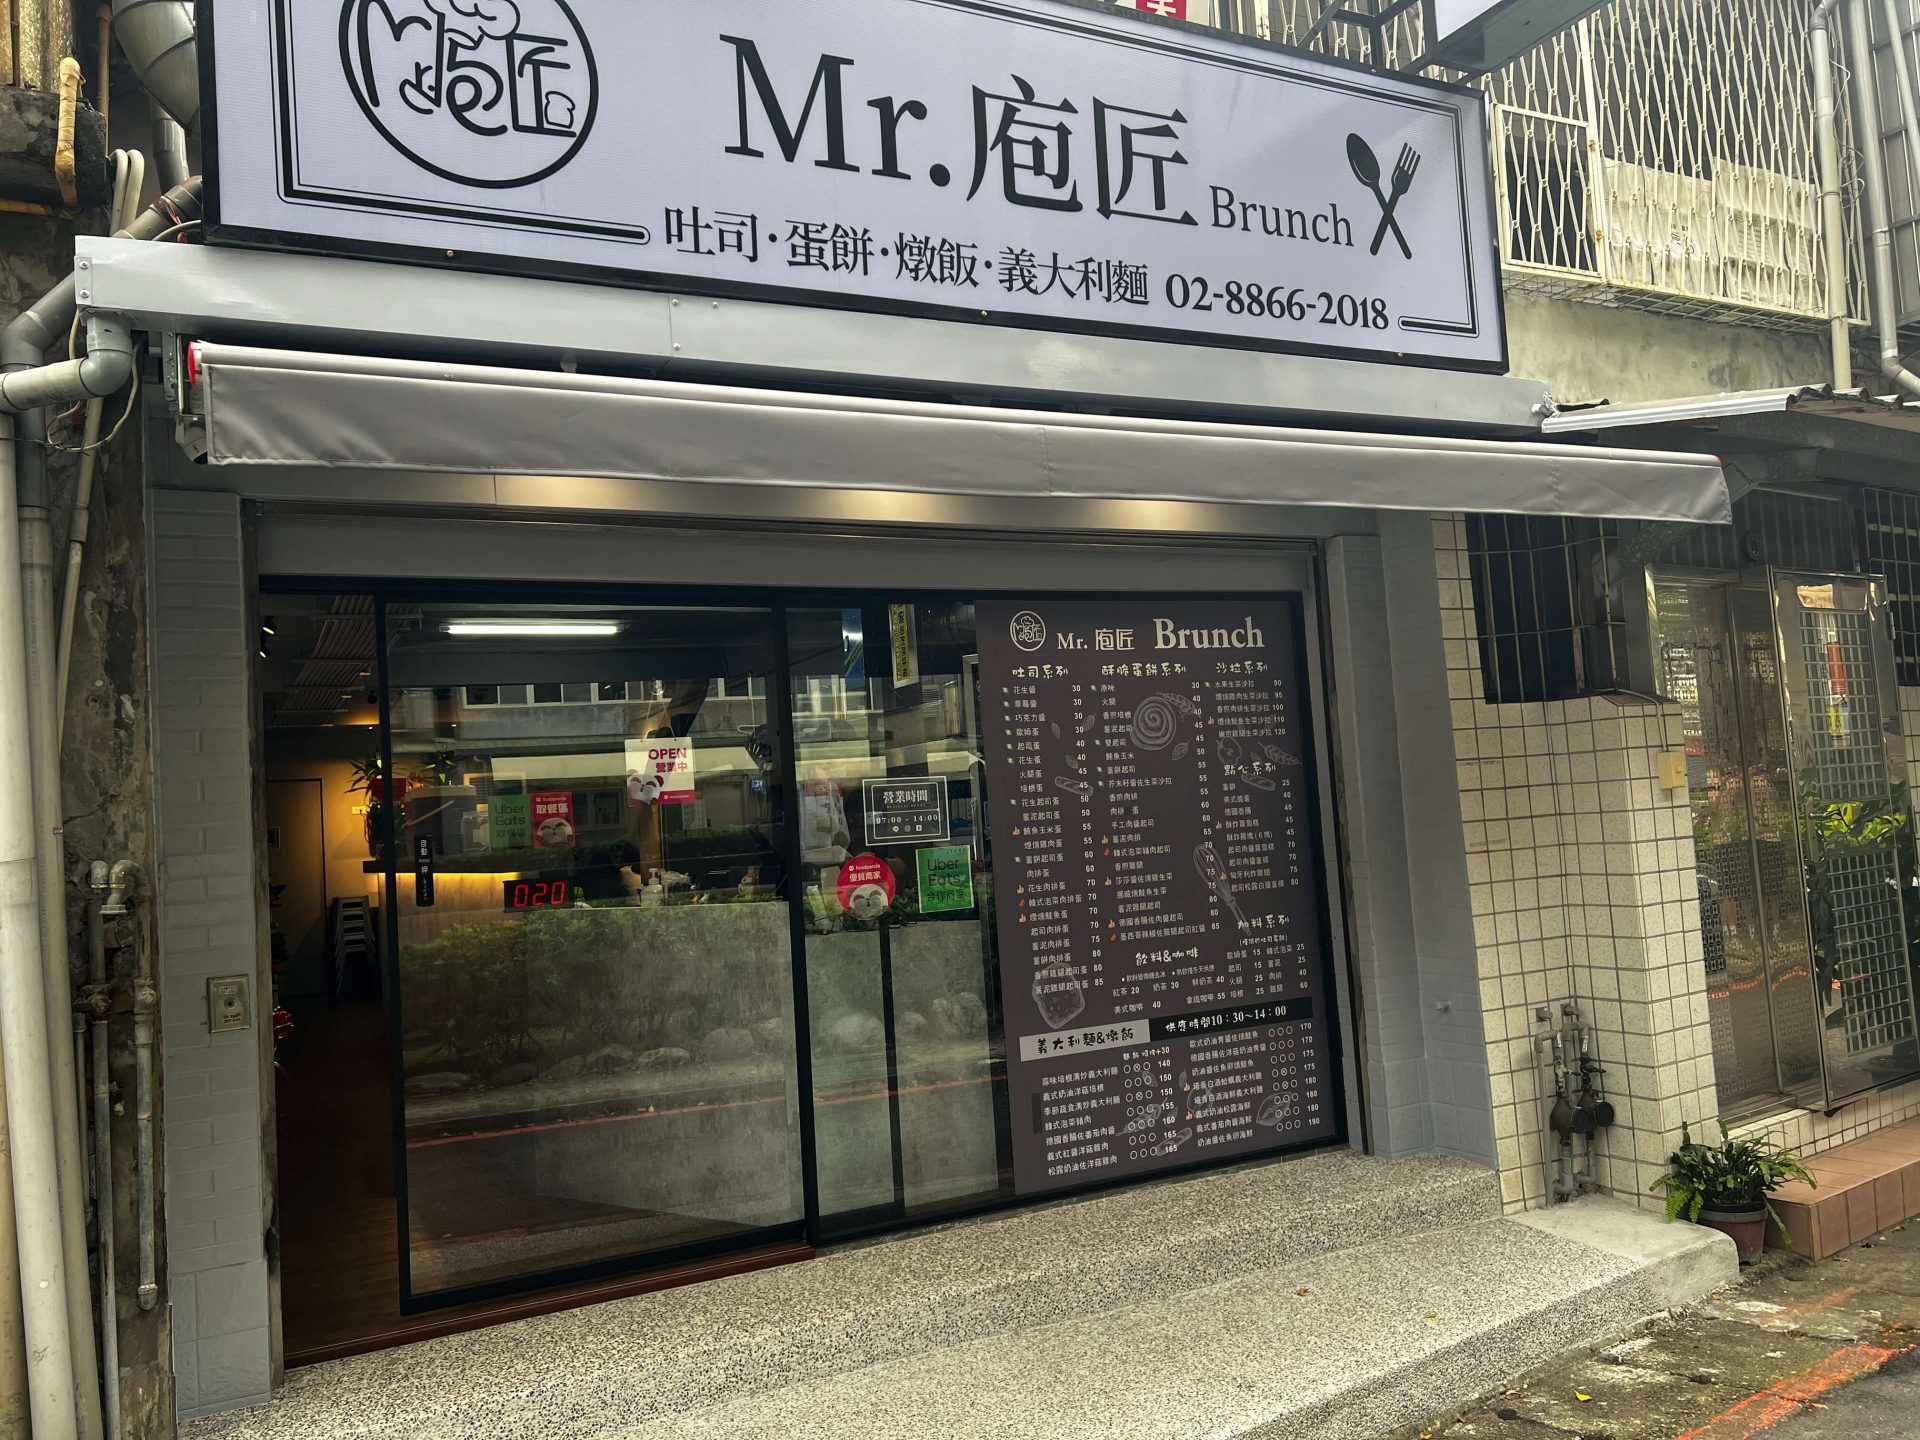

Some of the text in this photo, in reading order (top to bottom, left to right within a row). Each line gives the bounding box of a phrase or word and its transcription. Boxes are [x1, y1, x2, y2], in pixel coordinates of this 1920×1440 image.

[1210, 185, 1355, 248] Brunch
[1165, 273, 1390, 331] 02-8866-2018
[1056, 616, 1265, 651] Mr. 庖匠 Brunch
[1012, 664, 1068, 679] 吐司系列
[1101, 662, 1186, 677] 酥脆蛋餅系列
[1216, 661, 1268, 674] 沙拉系列
[1073, 698, 1082, 706] 30
[1196, 734, 1204, 742] 45
[648, 747, 687, 760] OPEN
[1019, 756, 1041, 765] 花生蛋
[655, 761, 688, 773] 營業中
[1199, 774, 1207, 782] 55
[882, 789, 928, 804] 營業時間
[1080, 795, 1089, 803] 50
[495, 805, 525, 814] Uber
[536, 803, 569, 814] 取餐區
[496, 816, 526, 826] Eats
[913, 814, 938, 822] 14:00
[1202, 814, 1211, 822] 60
[1205, 841, 1213, 849] 70
[1205, 854, 1214, 862] 70
[855, 864, 881, 872] foodpanda
[927, 858, 959, 872] Uber
[1085, 865, 1095, 873] 60
[1207, 868, 1215, 876] 75
[928, 872, 961, 886] Eats
[1087, 878, 1096, 886] 70
[1208, 881, 1216, 889] 75
[513, 881, 566, 908] 020
[1209, 895, 1218, 903] 80
[1237, 914, 1289, 929] 加料系列
[1211, 922, 1220, 930] 85
[1091, 935, 1100, 943] 75
[1092, 949, 1101, 957] 80
[1253, 948, 1261, 956] 15
[1135, 947, 1198, 966] 飲料&咖啡
[1093, 963, 1102, 972] 80
[1254, 961, 1262, 969] 15
[1094, 978, 1104, 986] 85
[1255, 974, 1263, 982] 25
[1131, 986, 1140, 994] 20
[1170, 981, 1179, 989] 30
[1216, 975, 1224, 983] 40
[1256, 987, 1264, 995] 25
[1152, 1000, 1161, 1008] 40
[1217, 992, 1226, 1000] 55
[1300, 1022, 1312, 1030] 170
[1301, 1036, 1313, 1044] 170
[1303, 1049, 1314, 1057] 175
[1158, 1059, 1171, 1068] 140
[1304, 1063, 1315, 1071] 175
[1159, 1073, 1172, 1082] 150
[1305, 1076, 1316, 1084] 180
[1160, 1087, 1173, 1096] 150
[1306, 1090, 1318, 1098] 180
[1160, 1101, 1174, 1110] 155
[1307, 1103, 1319, 1112] 180
[1163, 1115, 1175, 1124] 160
[1308, 1117, 1320, 1125] 190
[1164, 1130, 1177, 1139] 165
[1165, 1144, 1178, 1153] 165
